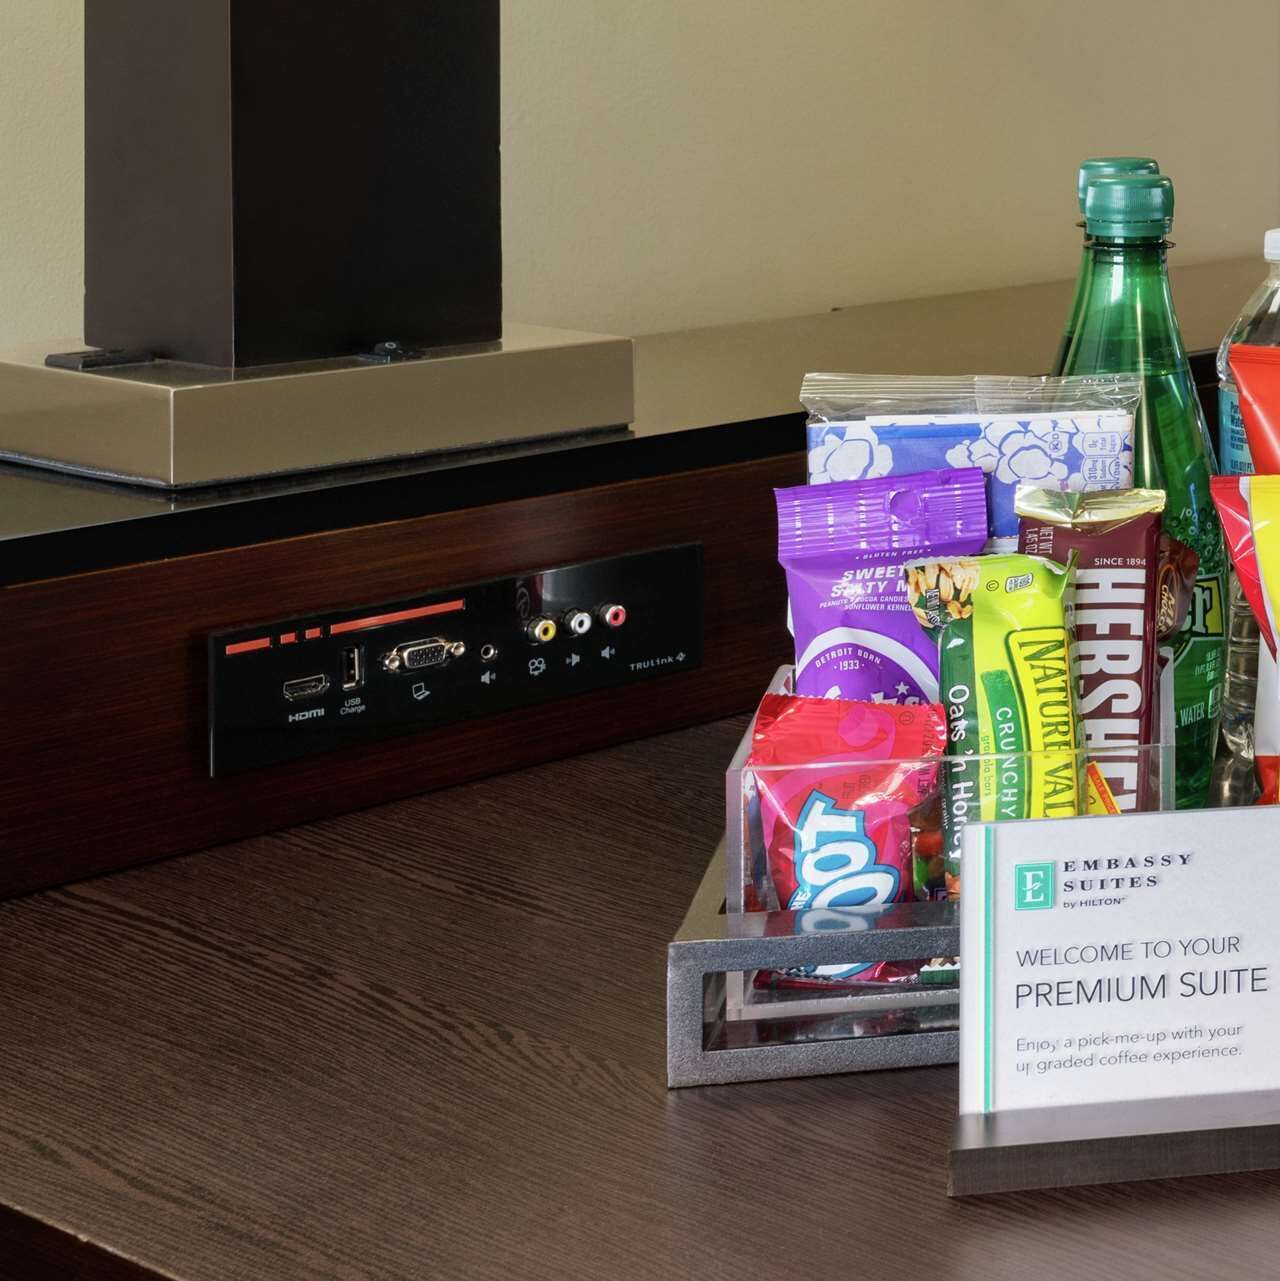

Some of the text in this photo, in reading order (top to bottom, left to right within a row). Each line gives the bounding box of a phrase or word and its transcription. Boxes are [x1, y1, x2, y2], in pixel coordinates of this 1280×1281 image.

[1025, 543, 1038, 554] OZ
[1039, 526, 1054, 555] NET WT
[862, 551, 898, 560] GLUTEN
[1094, 558, 1147, 566] SINCE 1894
[841, 564, 904, 582] SWEET
[887, 604, 912, 612] KERNEL
[816, 647, 882, 668] DETROIT BORN
[839, 660, 860, 671] 1933
[344, 698, 361, 707] USB
[1018, 636, 1073, 759] NATURE
[288, 708, 325, 723] HDMI
[340, 705, 367, 715] Charge
[948, 685, 970, 742] Oats
[1180, 702, 1206, 727] WATER
[981, 736, 993, 773] graola
[996, 707, 1019, 817] CRUNCHY
[1041, 760, 1076, 817] VAL
[1063, 854, 1193, 872] EMBASSY
[1063, 875, 1159, 892] SUITES
[1063, 901, 1076, 909] by
[1016, 936, 1241, 967] WELCOME TO YOUR
[1015, 967, 1268, 1009] PREMIUM SUITE
[1063, 1038, 1072, 1049] a
[1078, 1030, 1166, 1051] pick-me-up
[1171, 1024, 1203, 1041] with
[1208, 1025, 1243, 1044] your
[1099, 1048, 1148, 1065] coffee
[1153, 1045, 1243, 1064] experience.
